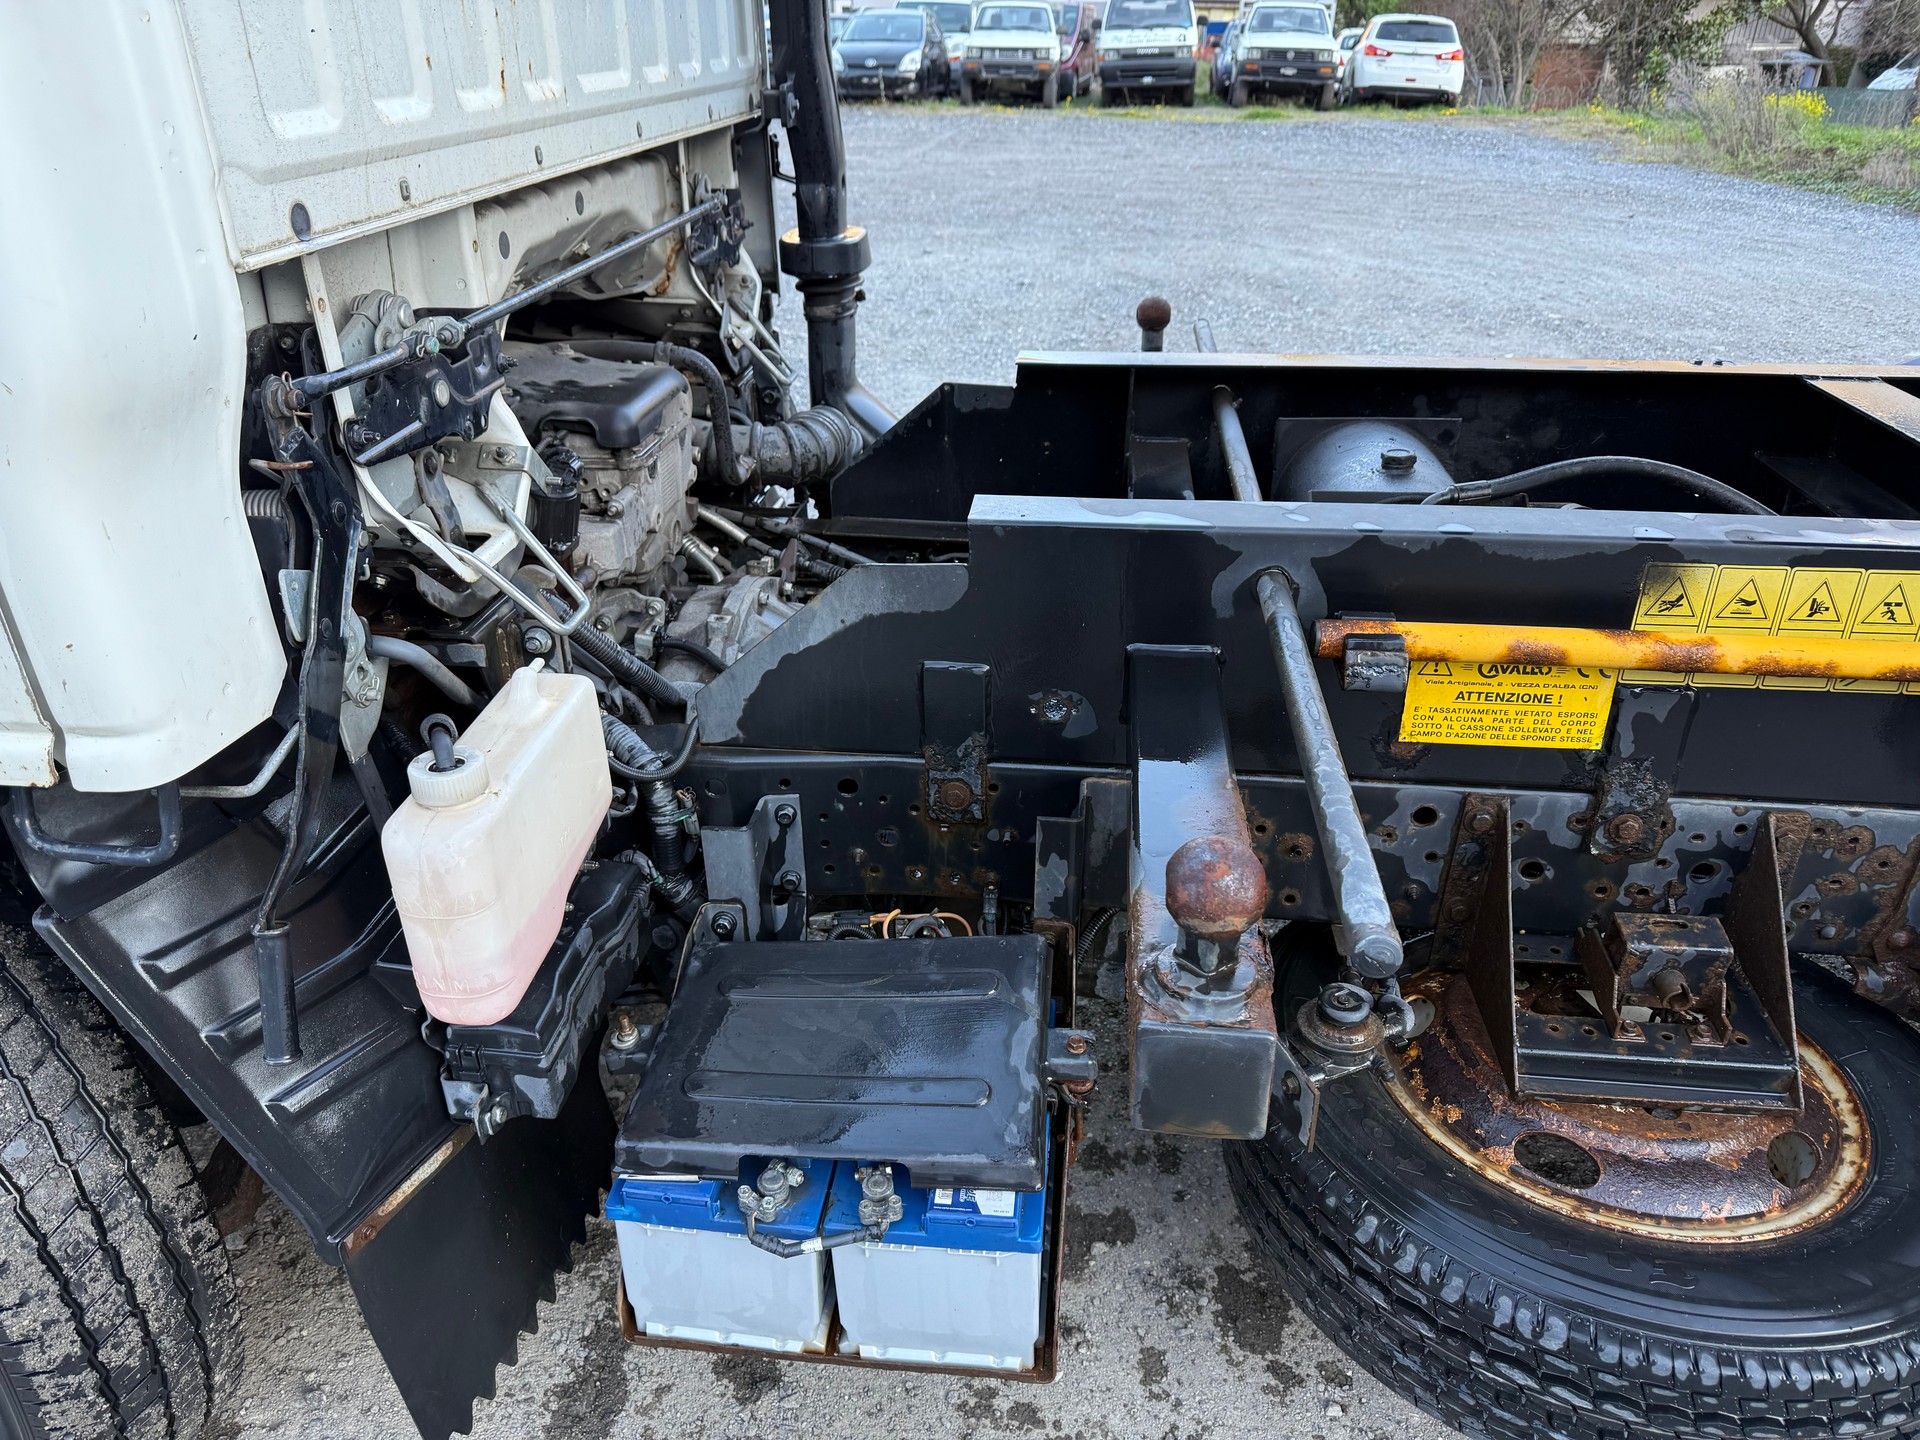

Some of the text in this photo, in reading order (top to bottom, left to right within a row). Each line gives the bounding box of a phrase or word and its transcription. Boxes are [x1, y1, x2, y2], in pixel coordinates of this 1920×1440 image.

[1455, 690, 1563, 704] ATTENZIONE !
[1428, 706, 1510, 716] TASSATIVAMENTE
[1515, 710, 1553, 718] VIETATO
[1557, 711, 1598, 719] ESPORSI
[1442, 715, 1484, 723] ALCUNA
[1411, 722, 1442, 730] SOTTO
[1459, 724, 1504, 732] CASSONE
[1508, 726, 1562, 734] SOLLEVATO
[1410, 730, 1442, 738] CAMPO
[1445, 731, 1487, 739] D'AZIONE
[1489, 733, 1518, 741] DELLE
[1520, 734, 1557, 742] SPONDE
[1326, 1073, 1697, 1292] Fireston
